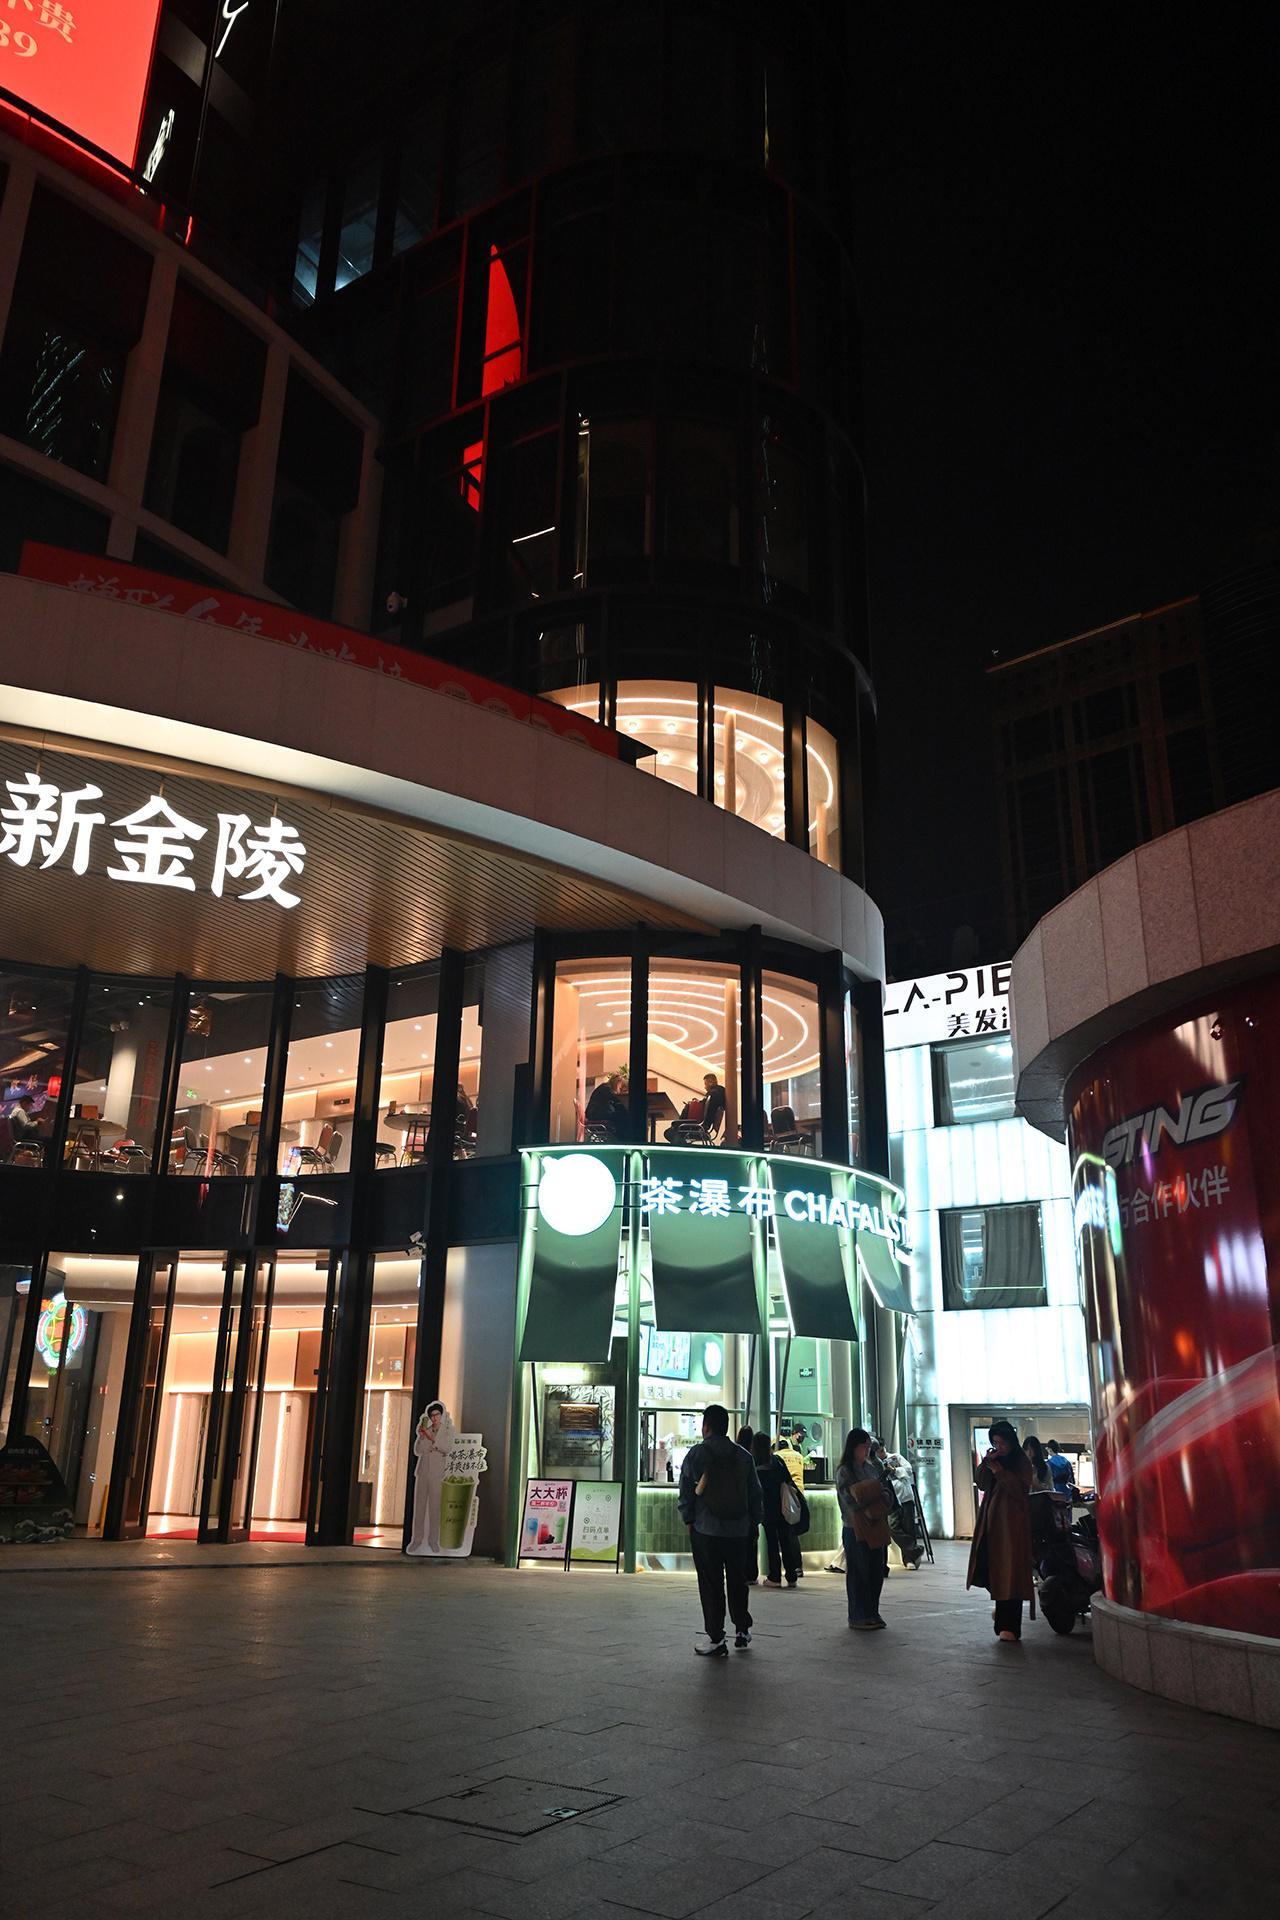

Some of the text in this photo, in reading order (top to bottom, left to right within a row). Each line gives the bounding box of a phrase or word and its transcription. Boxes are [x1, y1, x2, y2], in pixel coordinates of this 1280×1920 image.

[7, 0, 78, 44] 贵
[0, 771, 307, 910] 新金陵
[1102, 1080, 1241, 1169] STING
[638, 1176, 777, 1221] 茶瀑布
[530, 1486, 568, 1500] 大大杯
